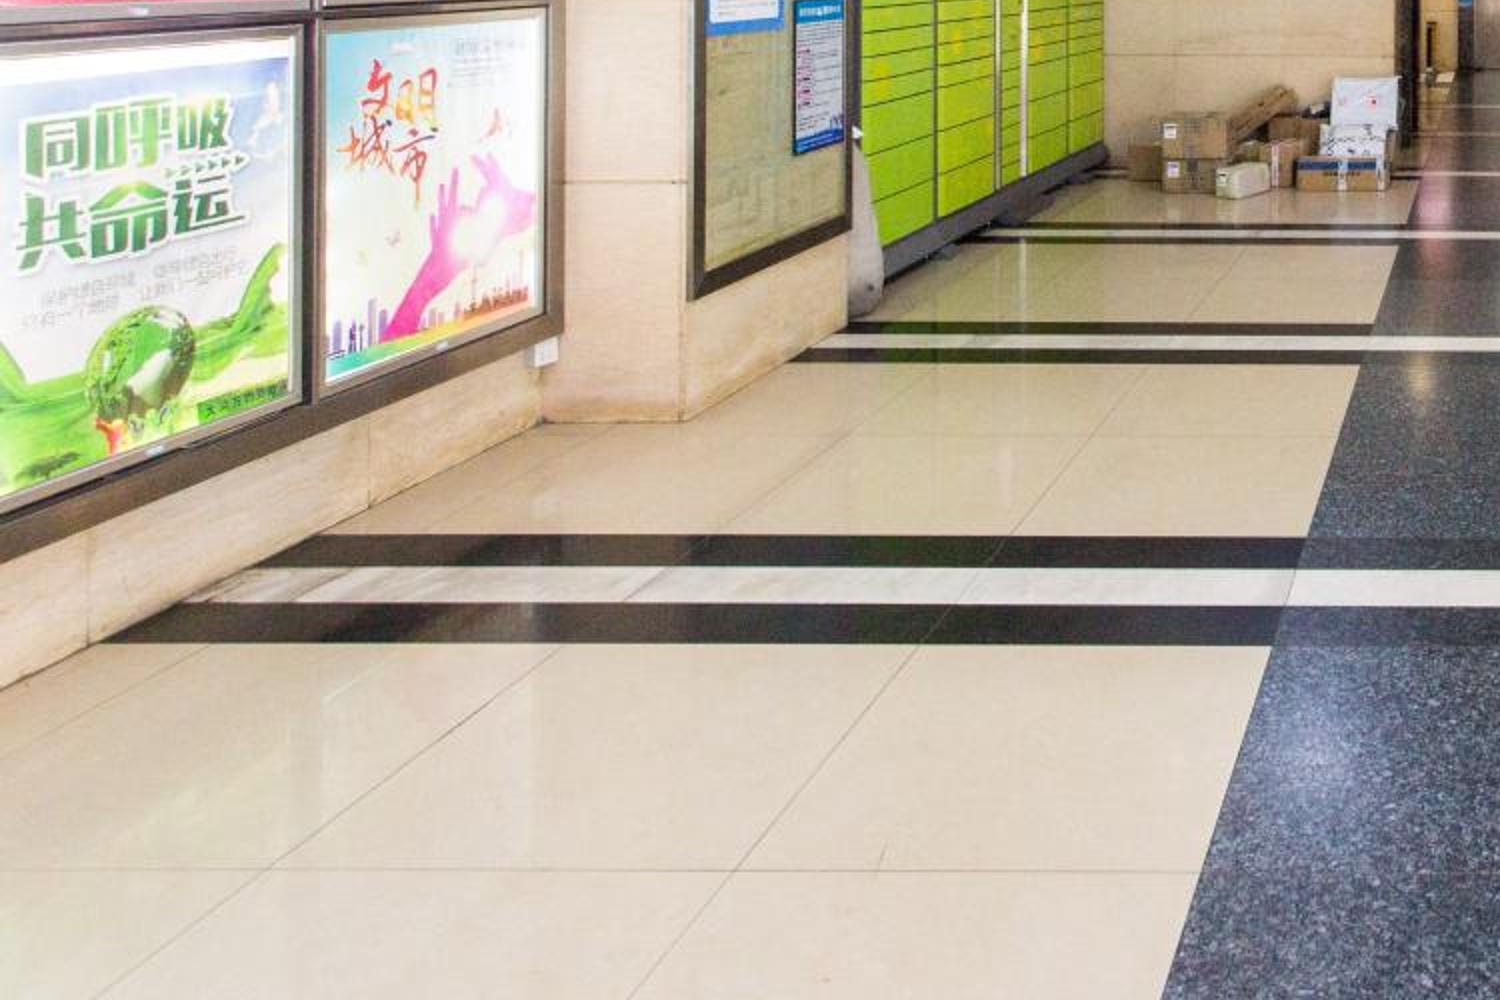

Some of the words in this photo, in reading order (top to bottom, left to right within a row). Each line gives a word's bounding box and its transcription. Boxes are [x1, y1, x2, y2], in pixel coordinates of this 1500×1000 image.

[361, 59, 438, 128] 文明
[22, 97, 233, 178] 同呼吸
[16, 174, 247, 271] 共命运
